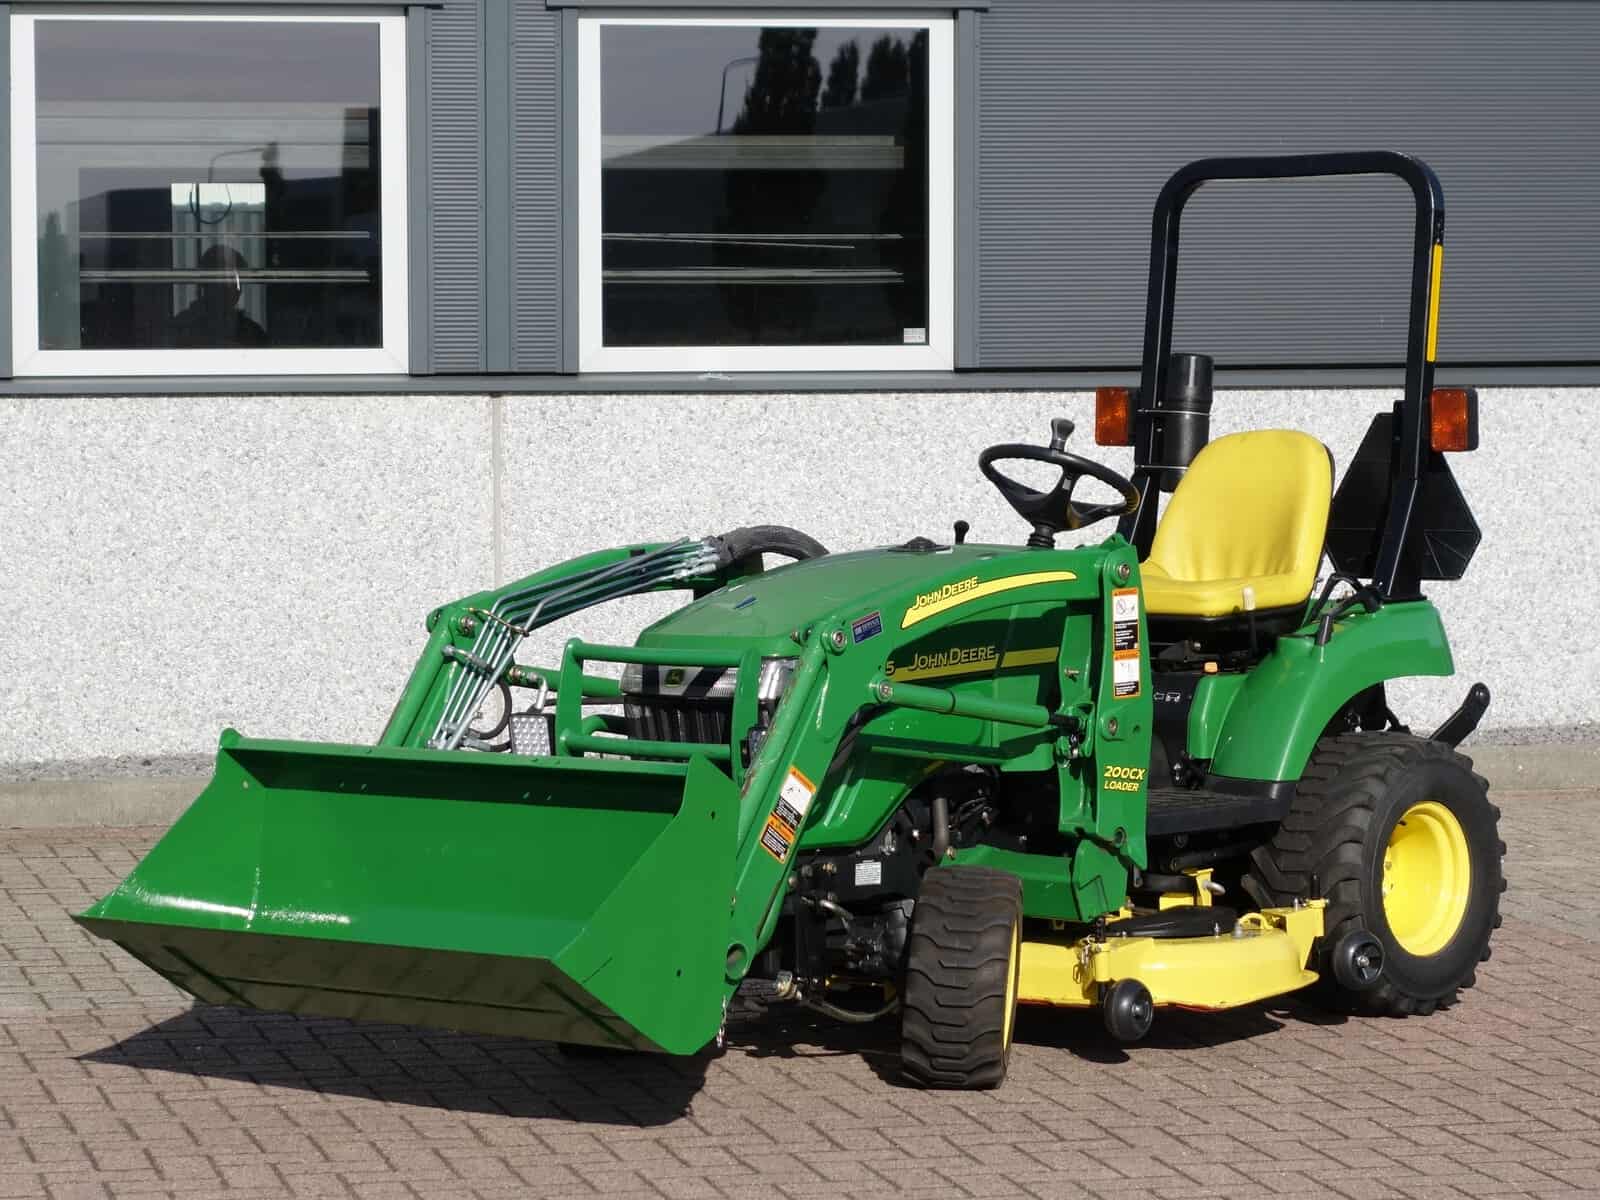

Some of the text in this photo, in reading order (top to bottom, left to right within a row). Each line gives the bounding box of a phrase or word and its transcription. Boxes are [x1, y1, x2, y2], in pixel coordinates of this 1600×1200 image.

[911, 576, 979, 610] JOHN DEERE
[908, 645, 996, 671] JOHN DEERE
[1103, 765, 1146, 780] 200CX
[1103, 780, 1140, 792] LOADER
